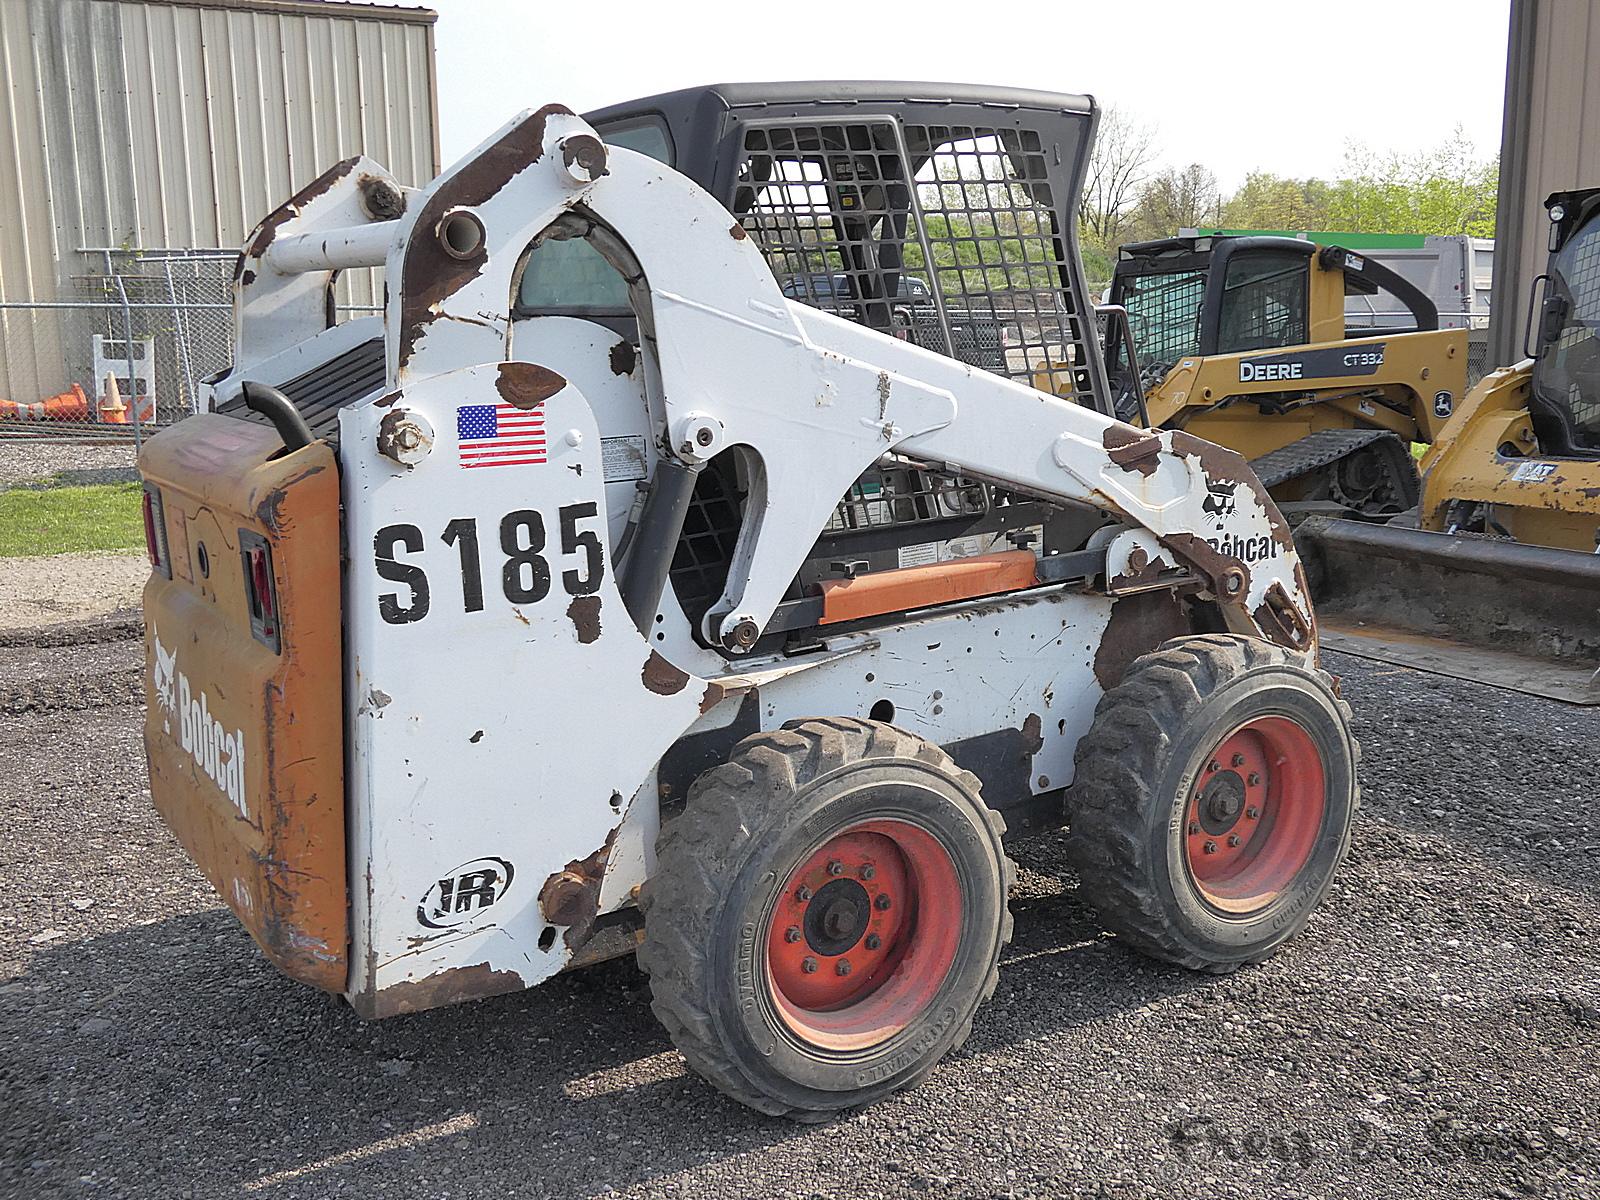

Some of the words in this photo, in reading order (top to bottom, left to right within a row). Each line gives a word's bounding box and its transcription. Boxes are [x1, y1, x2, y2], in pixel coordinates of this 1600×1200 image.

[1239, 363, 1303, 382] DEERE
[1343, 352, 1384, 367] CT332
[374, 501, 605, 625] S185
[178, 671, 248, 818] Bobcat
